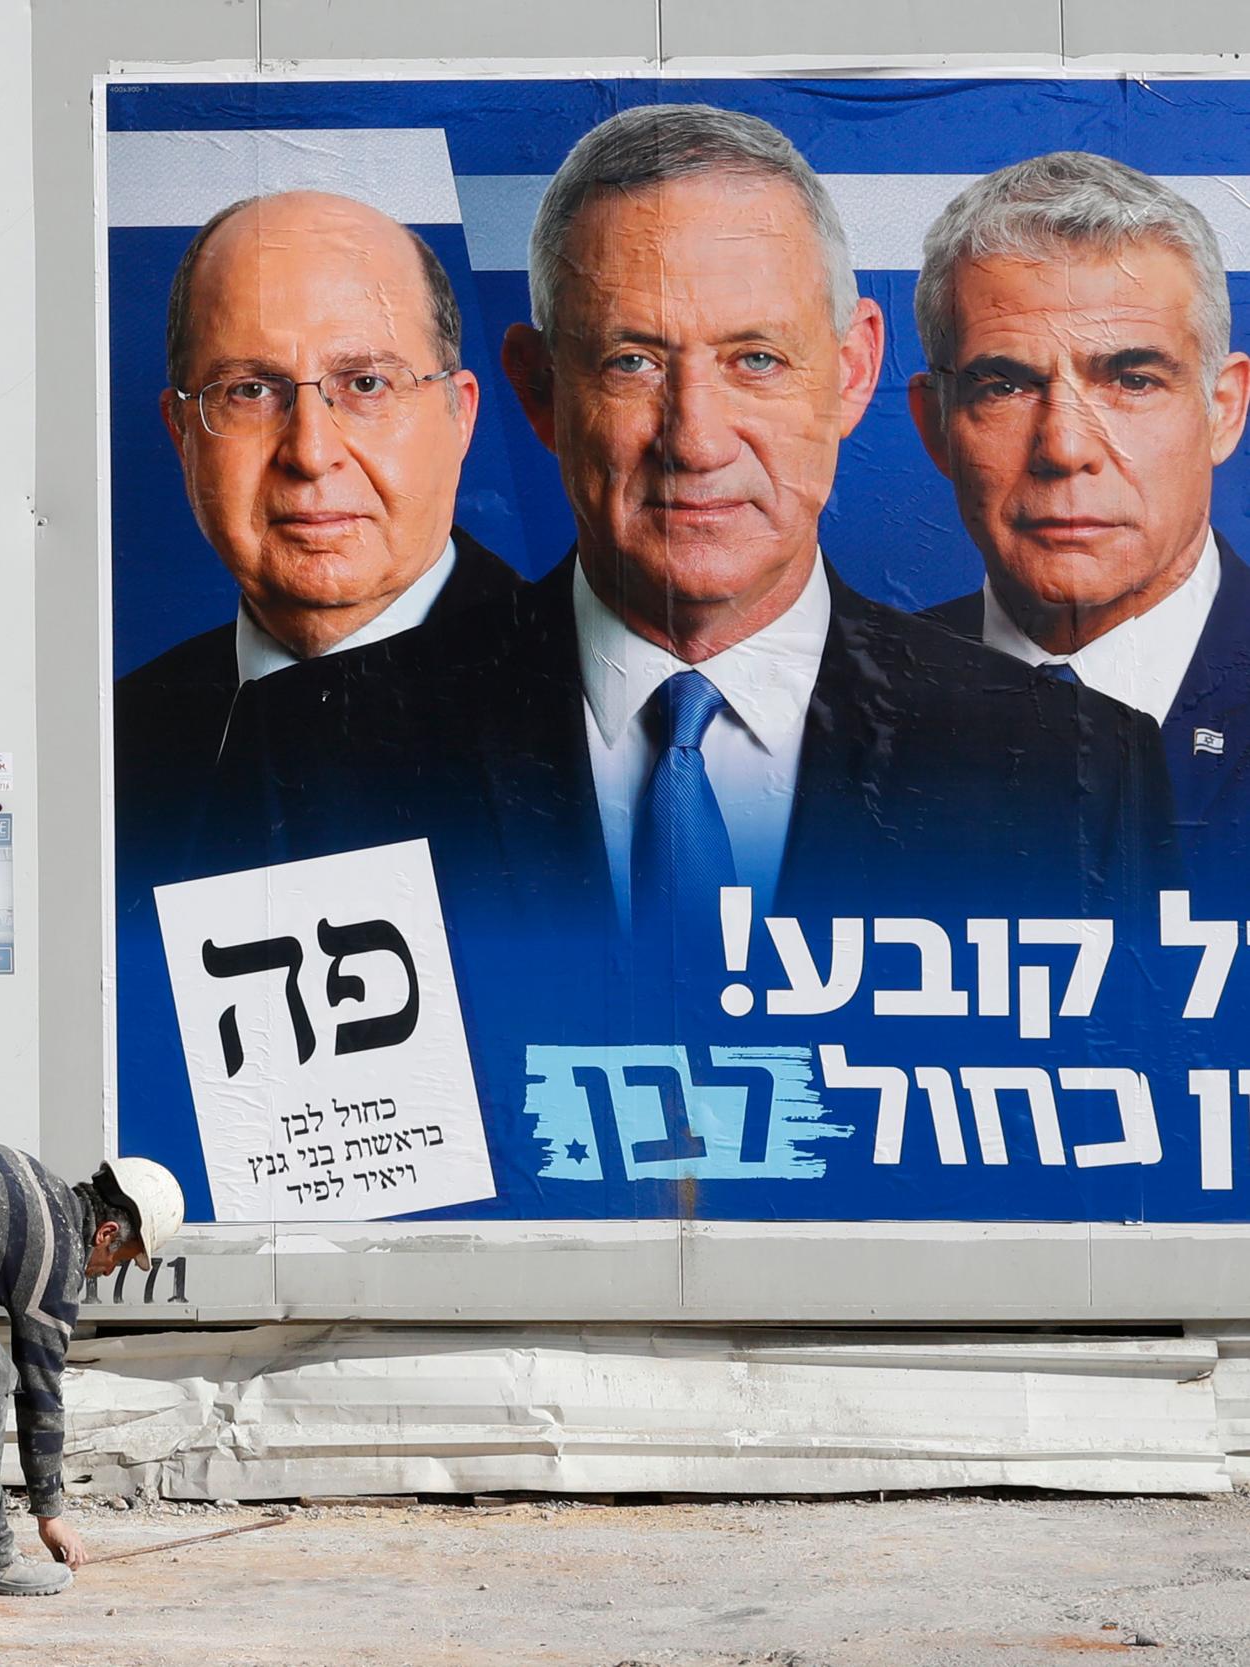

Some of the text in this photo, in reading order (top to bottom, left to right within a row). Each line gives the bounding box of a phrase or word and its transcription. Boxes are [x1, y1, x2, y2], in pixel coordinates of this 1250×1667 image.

[202, 917, 420, 1079] פה
[719, 887, 1114, 1039] קובע!
[248, 1124, 444, 1184] בראשות בני גנץ
[281, 1098, 397, 1144] כחול לבן
[568, 1045, 778, 1181] לבן
[818, 1044, 1163, 1168] כחול
[287, 1163, 417, 1205] ויאיר לפיד
